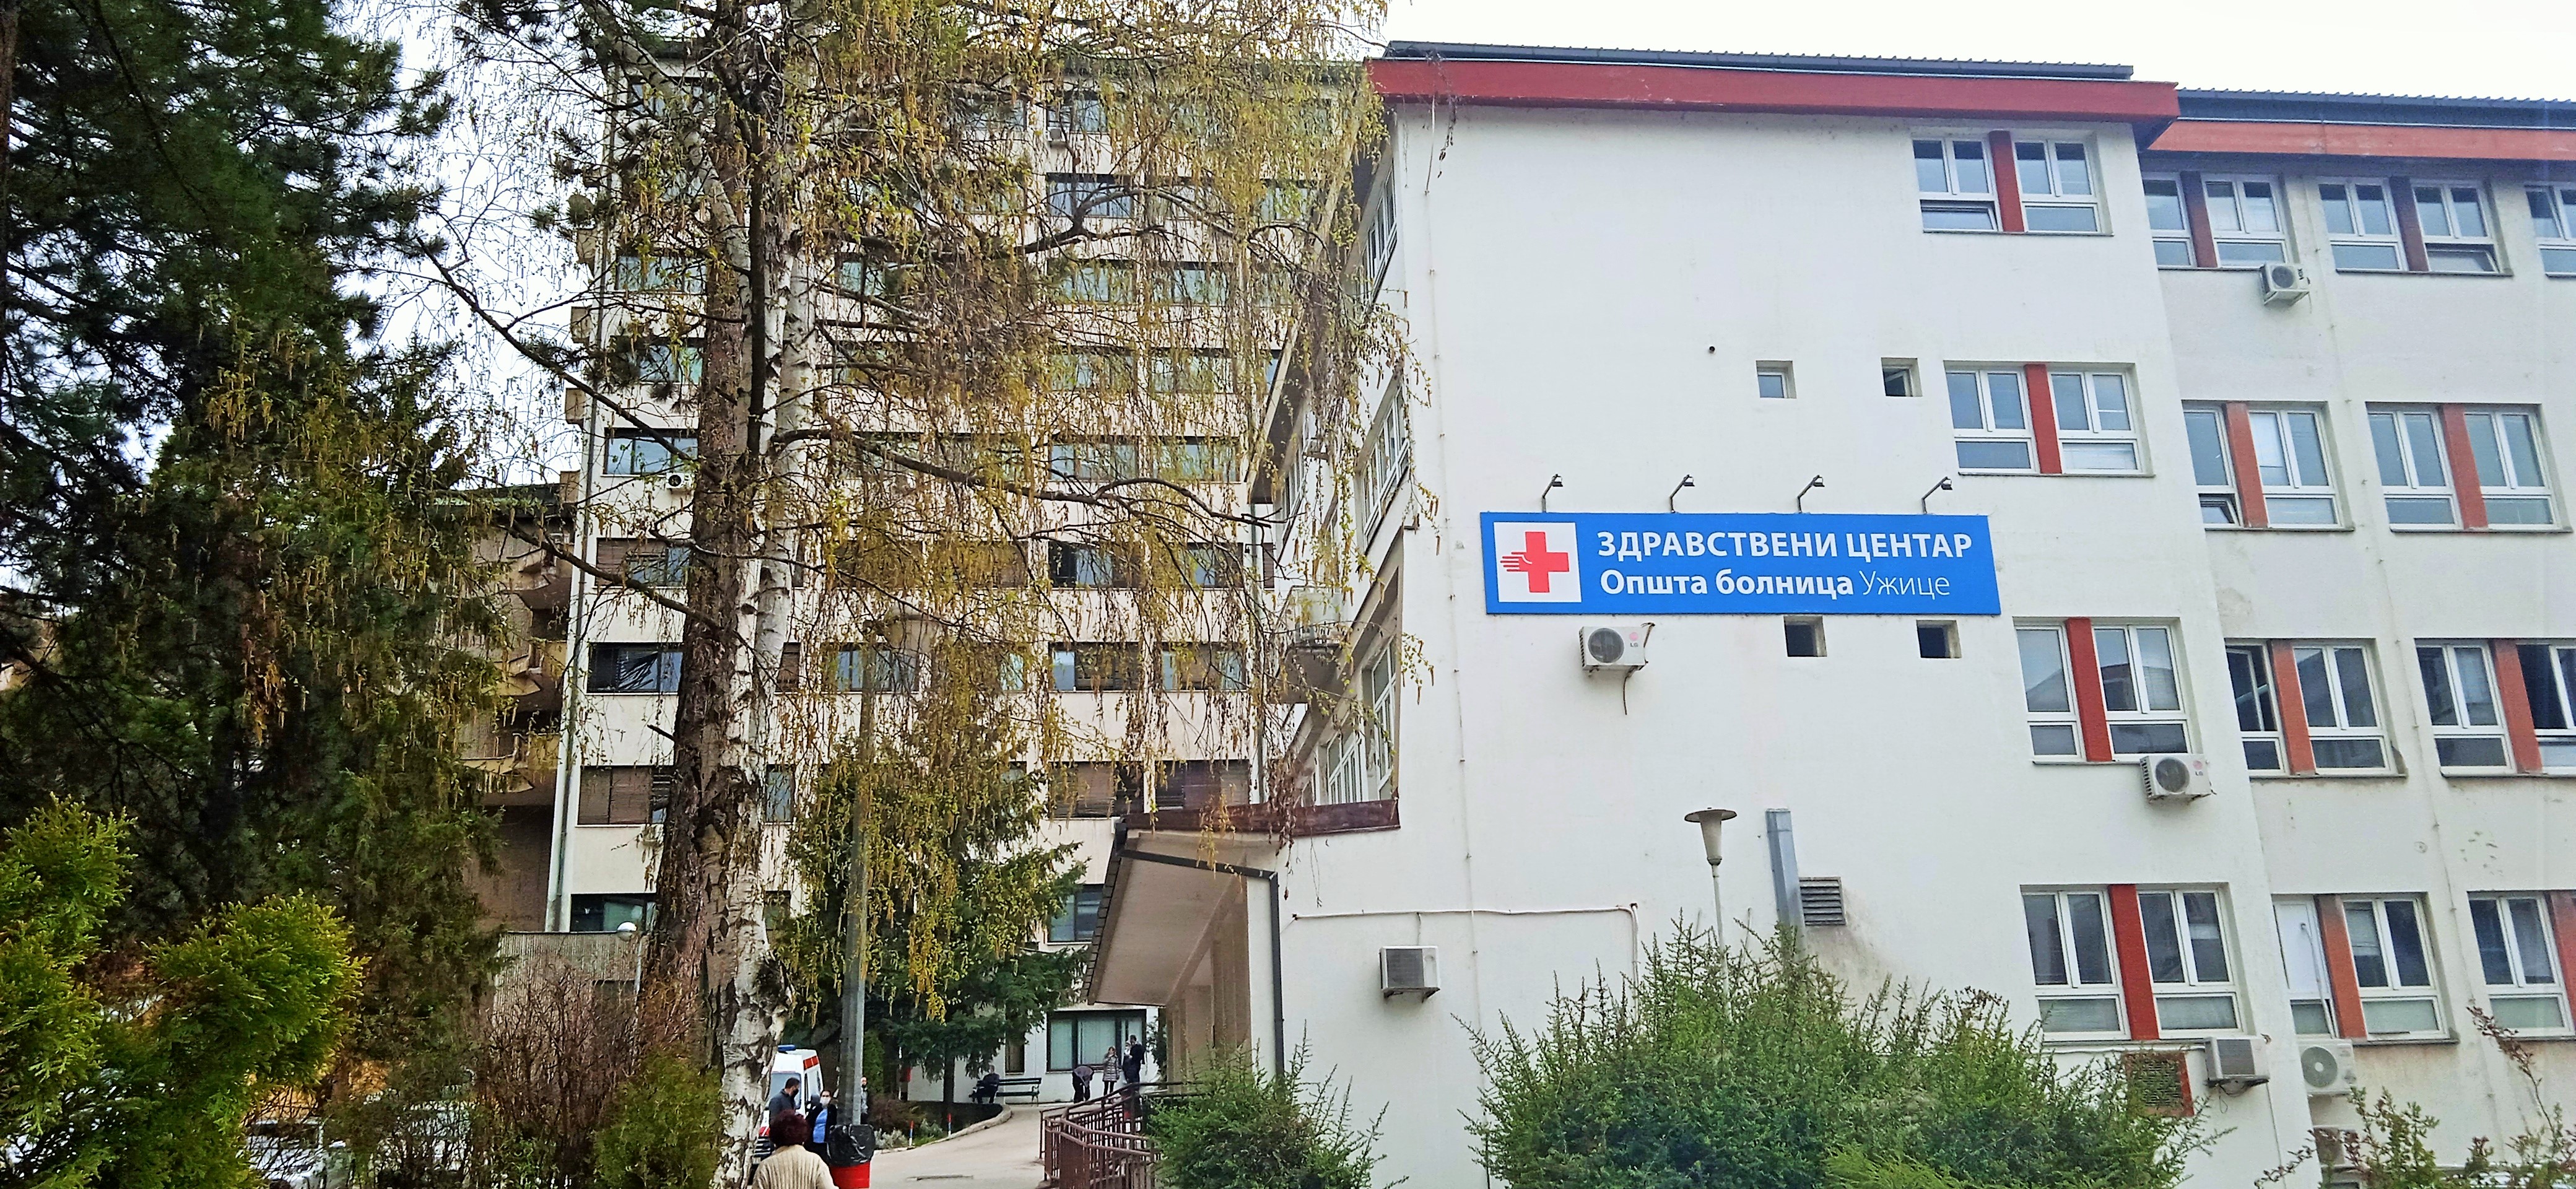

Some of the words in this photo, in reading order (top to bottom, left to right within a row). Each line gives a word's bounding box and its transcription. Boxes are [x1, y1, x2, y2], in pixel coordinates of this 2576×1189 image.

[1597, 531, 1838, 562] ЗДРАВСТВЕНИ
[1846, 533, 1972, 563] ЦЕНТАР
[1600, 568, 1708, 594] Општа
[1715, 568, 1854, 600] болница
[1858, 570, 1951, 600] Ужице
